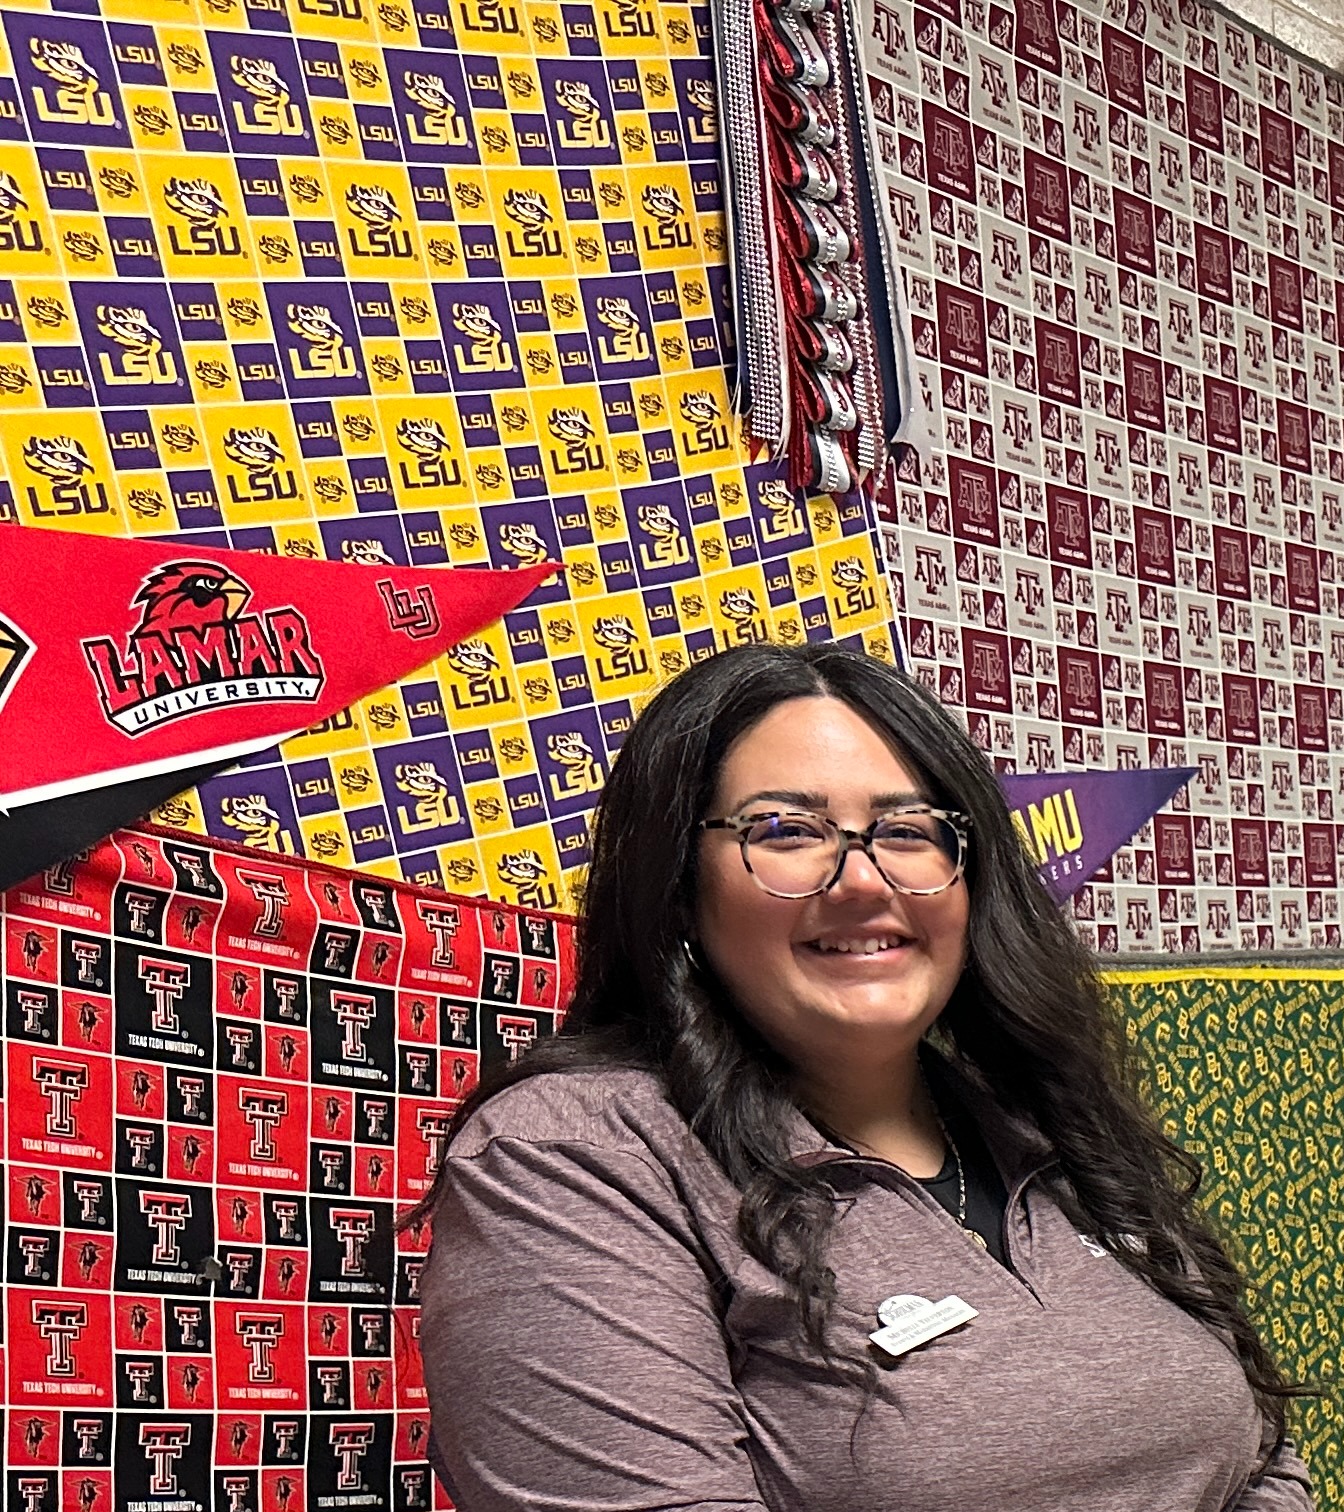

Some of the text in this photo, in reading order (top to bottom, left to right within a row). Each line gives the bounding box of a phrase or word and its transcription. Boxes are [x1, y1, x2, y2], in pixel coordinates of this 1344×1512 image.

[460, 2, 519, 34] LSU
[116, 45, 155, 65] LSU
[468, 75, 498, 90] LSU
[32, 87, 116, 126] LSU
[233, 101, 304, 137] LSU
[181, 114, 218, 131] LSU
[406, 114, 468, 145] LSU
[556, 119, 611, 149] LSU
[45, 171, 85, 189] LSU
[168, 225, 241, 256] LSU
[506, 230, 562, 257] LSU
[643, 222, 692, 250] LSU
[289, 347, 357, 379] LSU
[598, 334, 649, 363] LSU
[41, 369, 84, 386] LSU
[99, 351, 178, 386] LSU
[227, 471, 298, 503] LSU
[399, 459, 462, 489] LSU
[27, 483, 112, 518] LSU
[639, 541, 691, 570] LSU
[87, 610, 321, 709] LAMAR
[135, 680, 305, 725] UNIVERSITY
